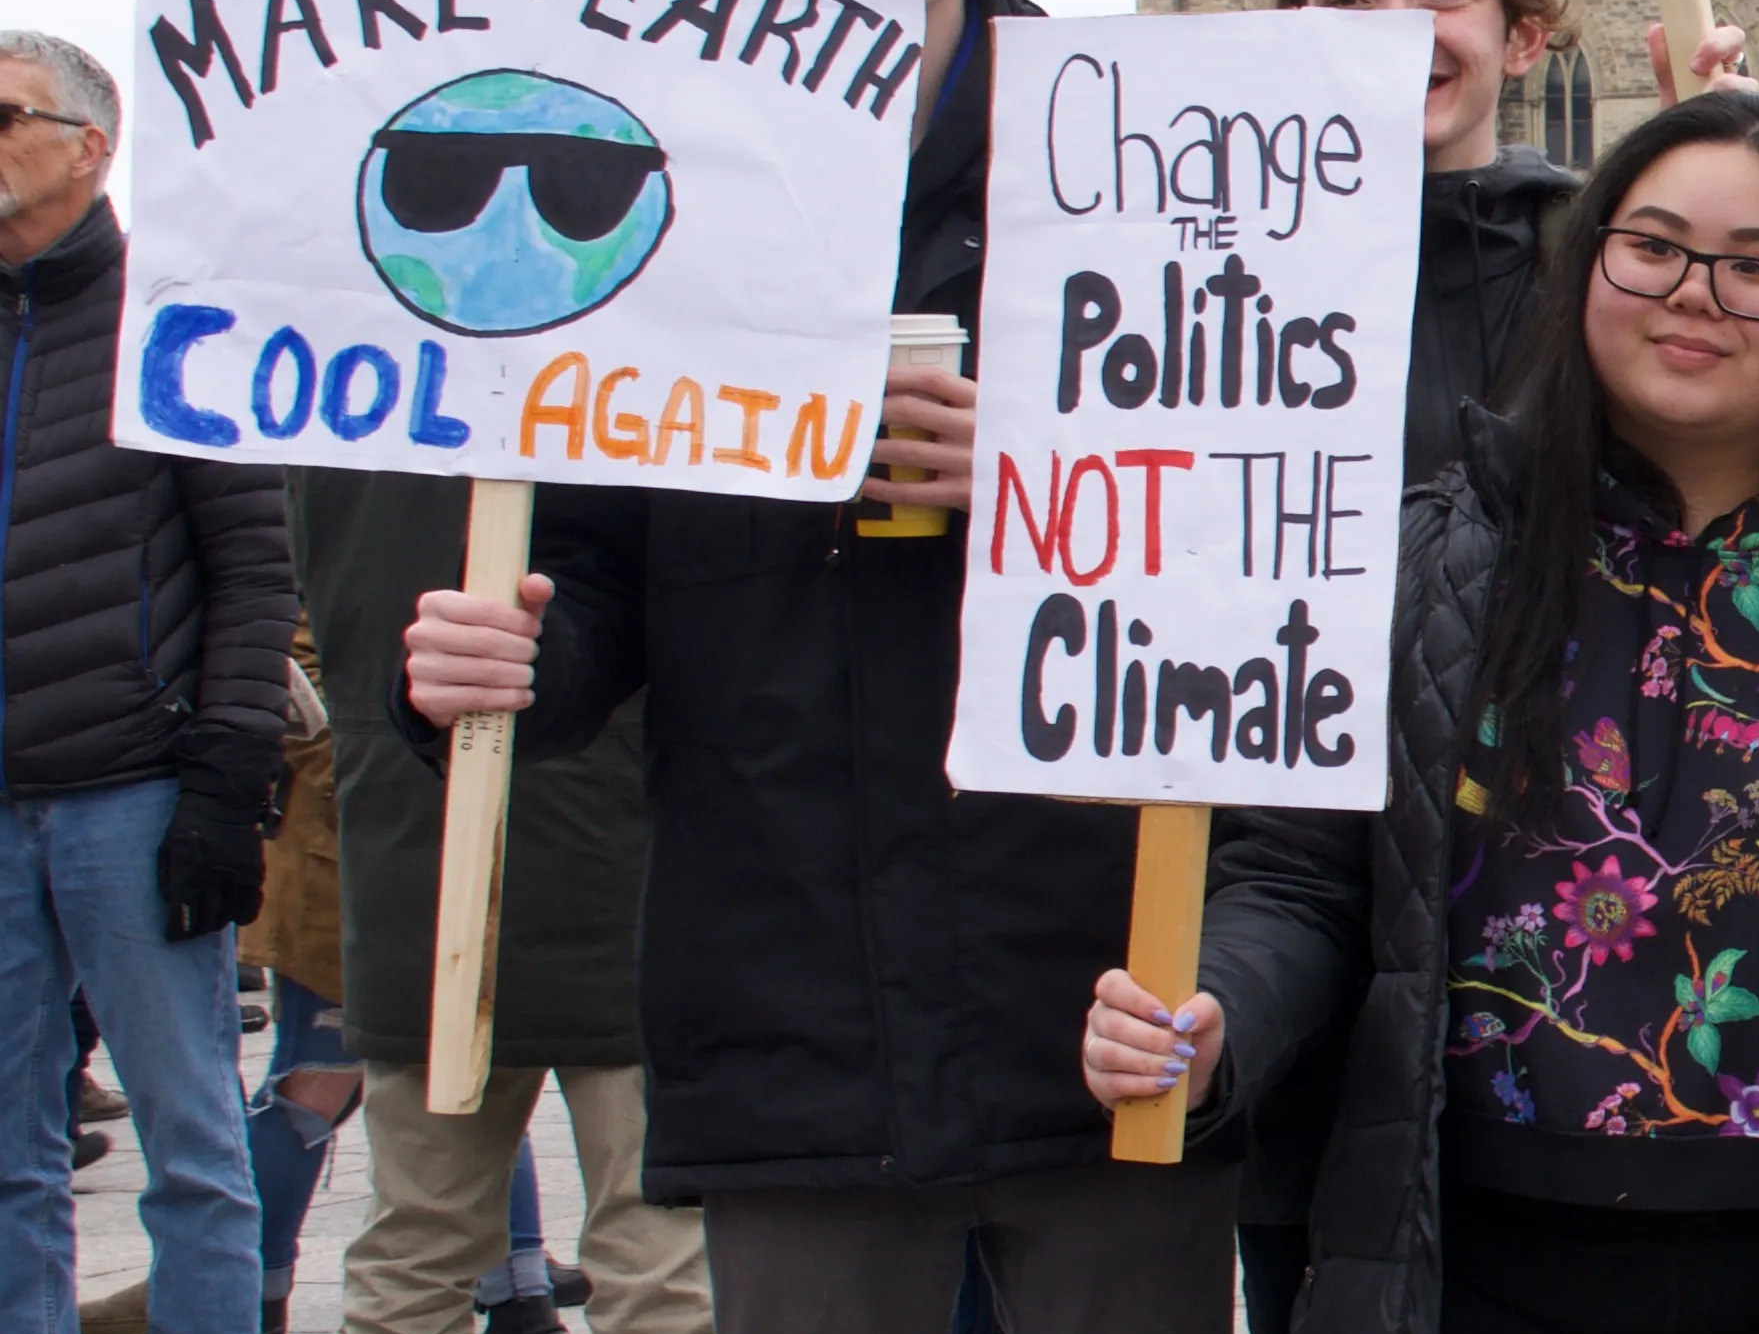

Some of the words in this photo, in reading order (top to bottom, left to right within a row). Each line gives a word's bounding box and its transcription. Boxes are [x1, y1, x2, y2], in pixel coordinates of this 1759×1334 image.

[1047, 52, 1364, 241] Change
[1171, 216, 1239, 252] THE
[140, 302, 472, 449] COOL
[518, 351, 864, 480] AGAIN
[1056, 254, 1357, 415] Politics
[991, 449, 1194, 587] NOT
[1208, 451, 1373, 581] THE
[1021, 592, 1355, 770] Climate
